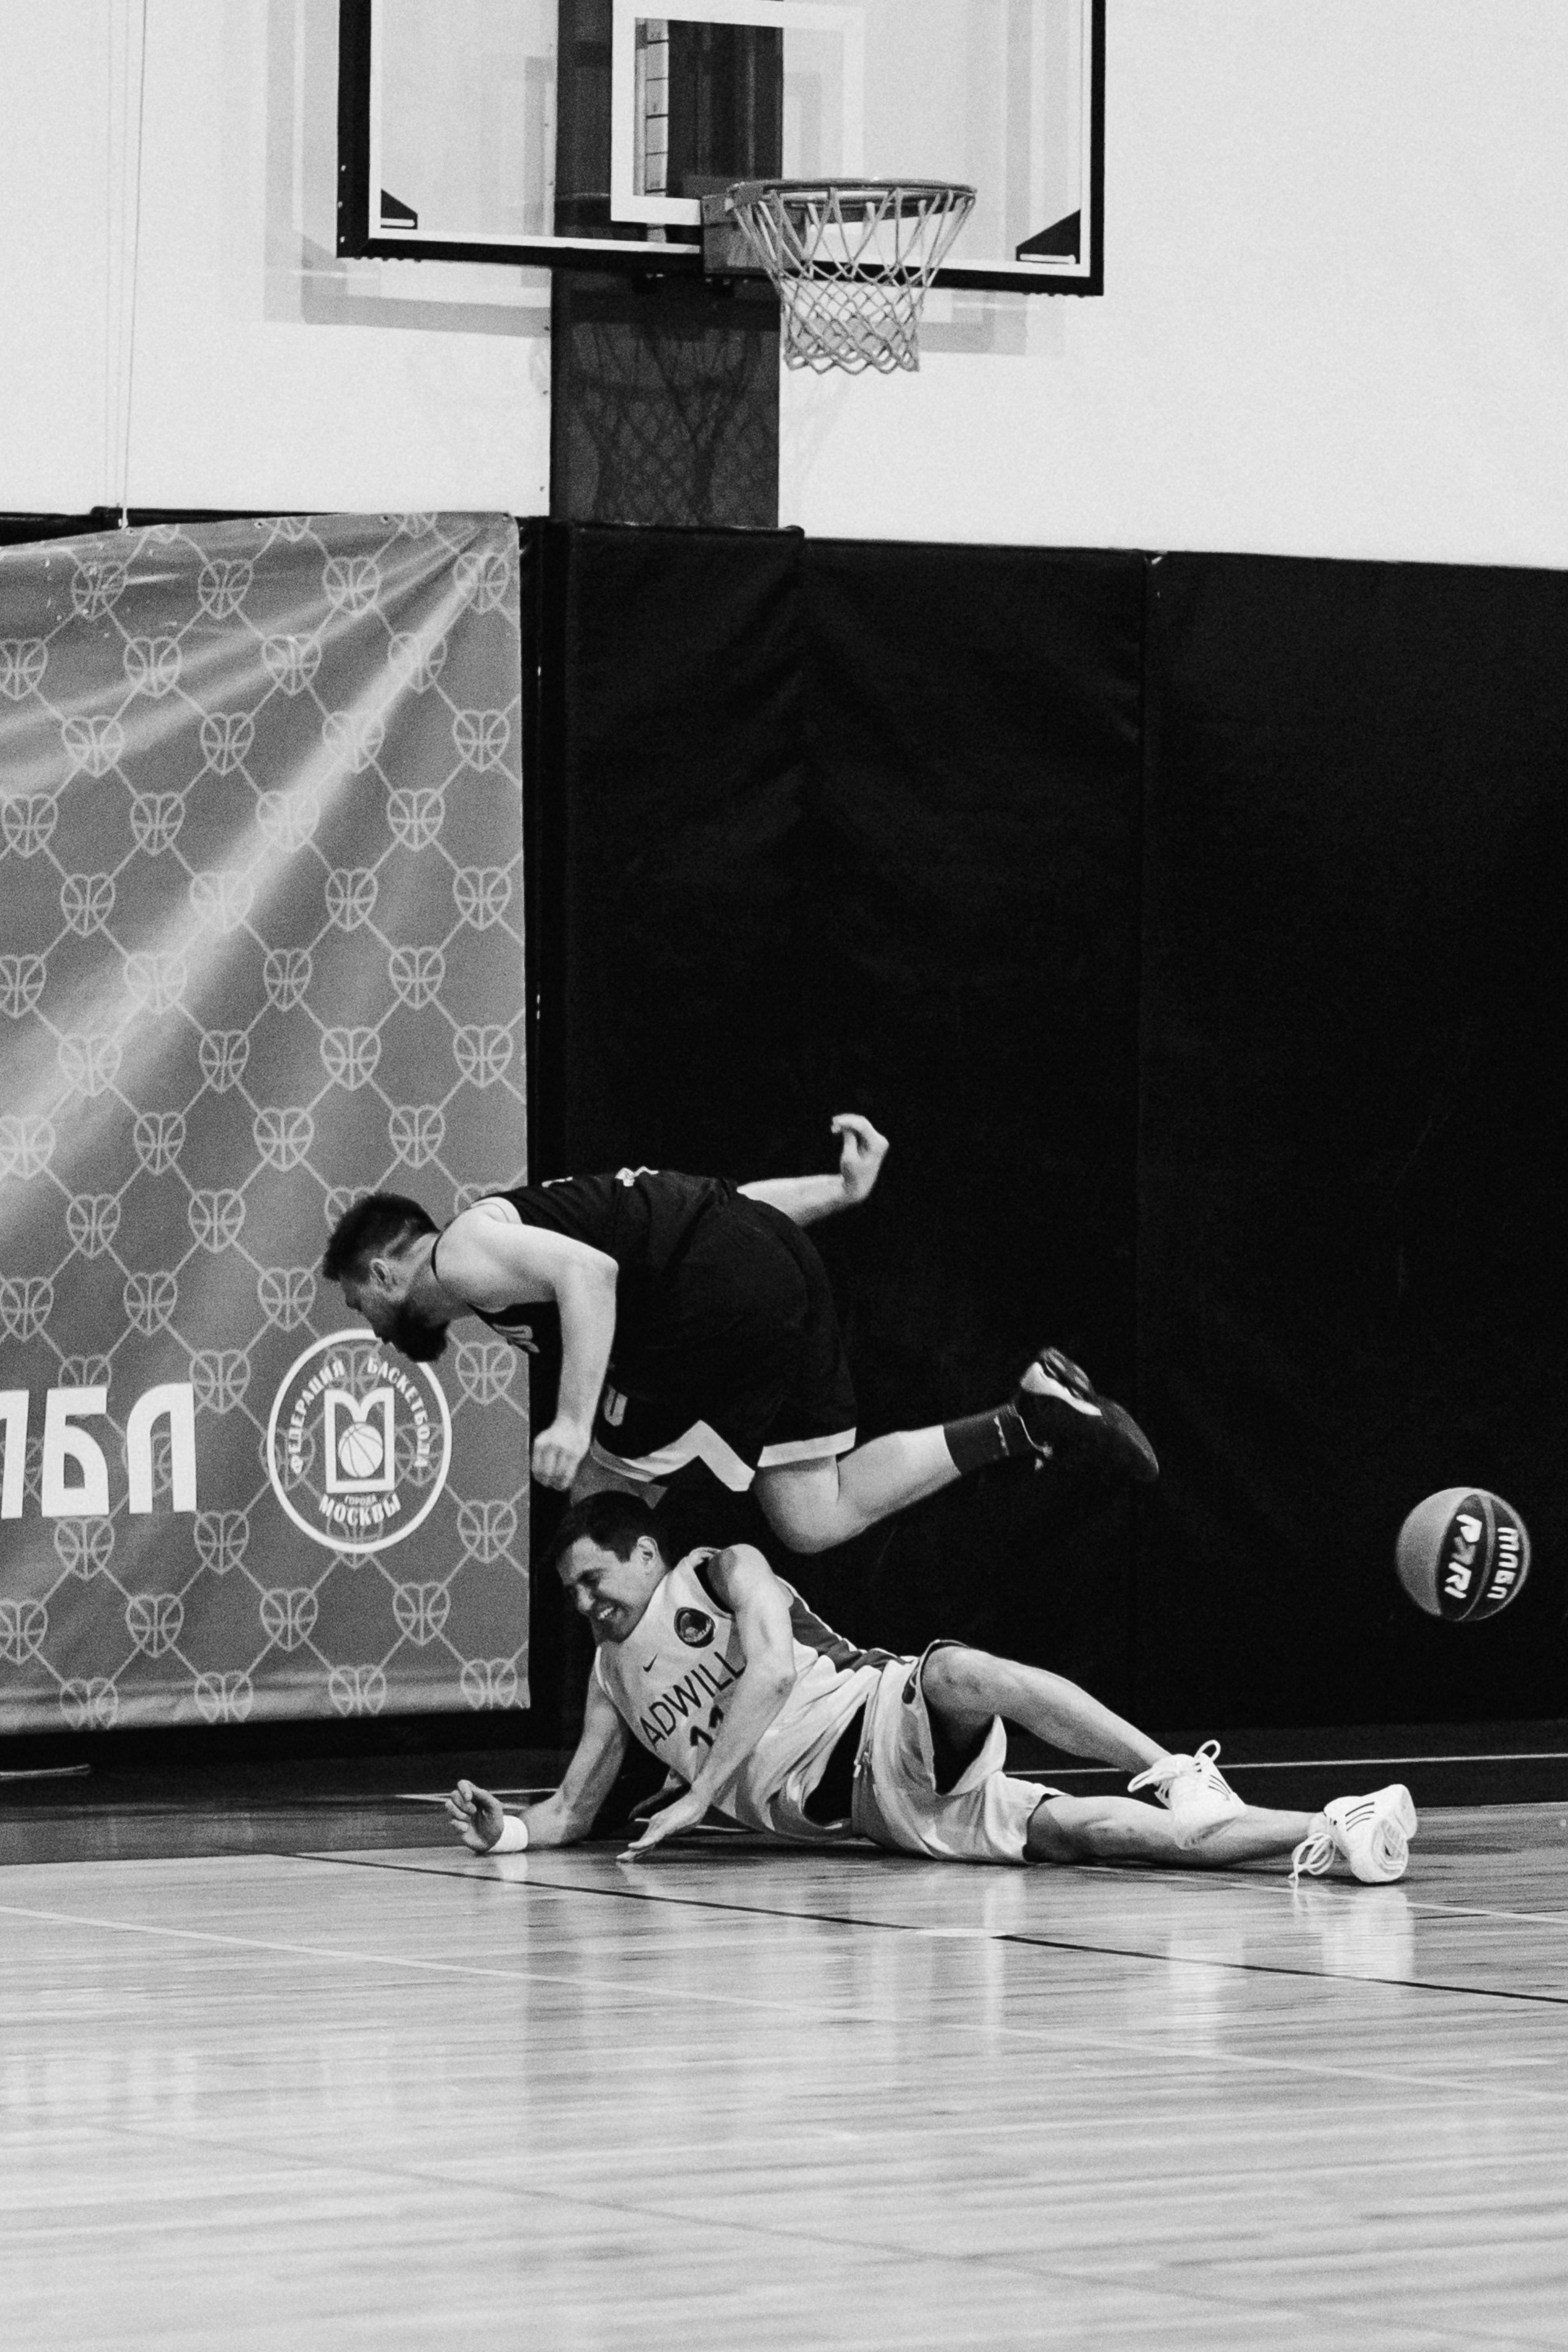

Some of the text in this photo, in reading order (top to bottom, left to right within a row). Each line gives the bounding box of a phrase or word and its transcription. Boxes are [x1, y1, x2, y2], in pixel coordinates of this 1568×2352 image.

[288, 1357, 431, 1474] ФЕДЕРАЦИЯ БАСКЕТБОЛА
[318, 1493, 401, 1526] МОСКВЫ
[344, 1494, 377, 1506] ГОРОДА
[1444, 1513, 1482, 1599] PARI
[640, 1651, 747, 1747] ADWILL
